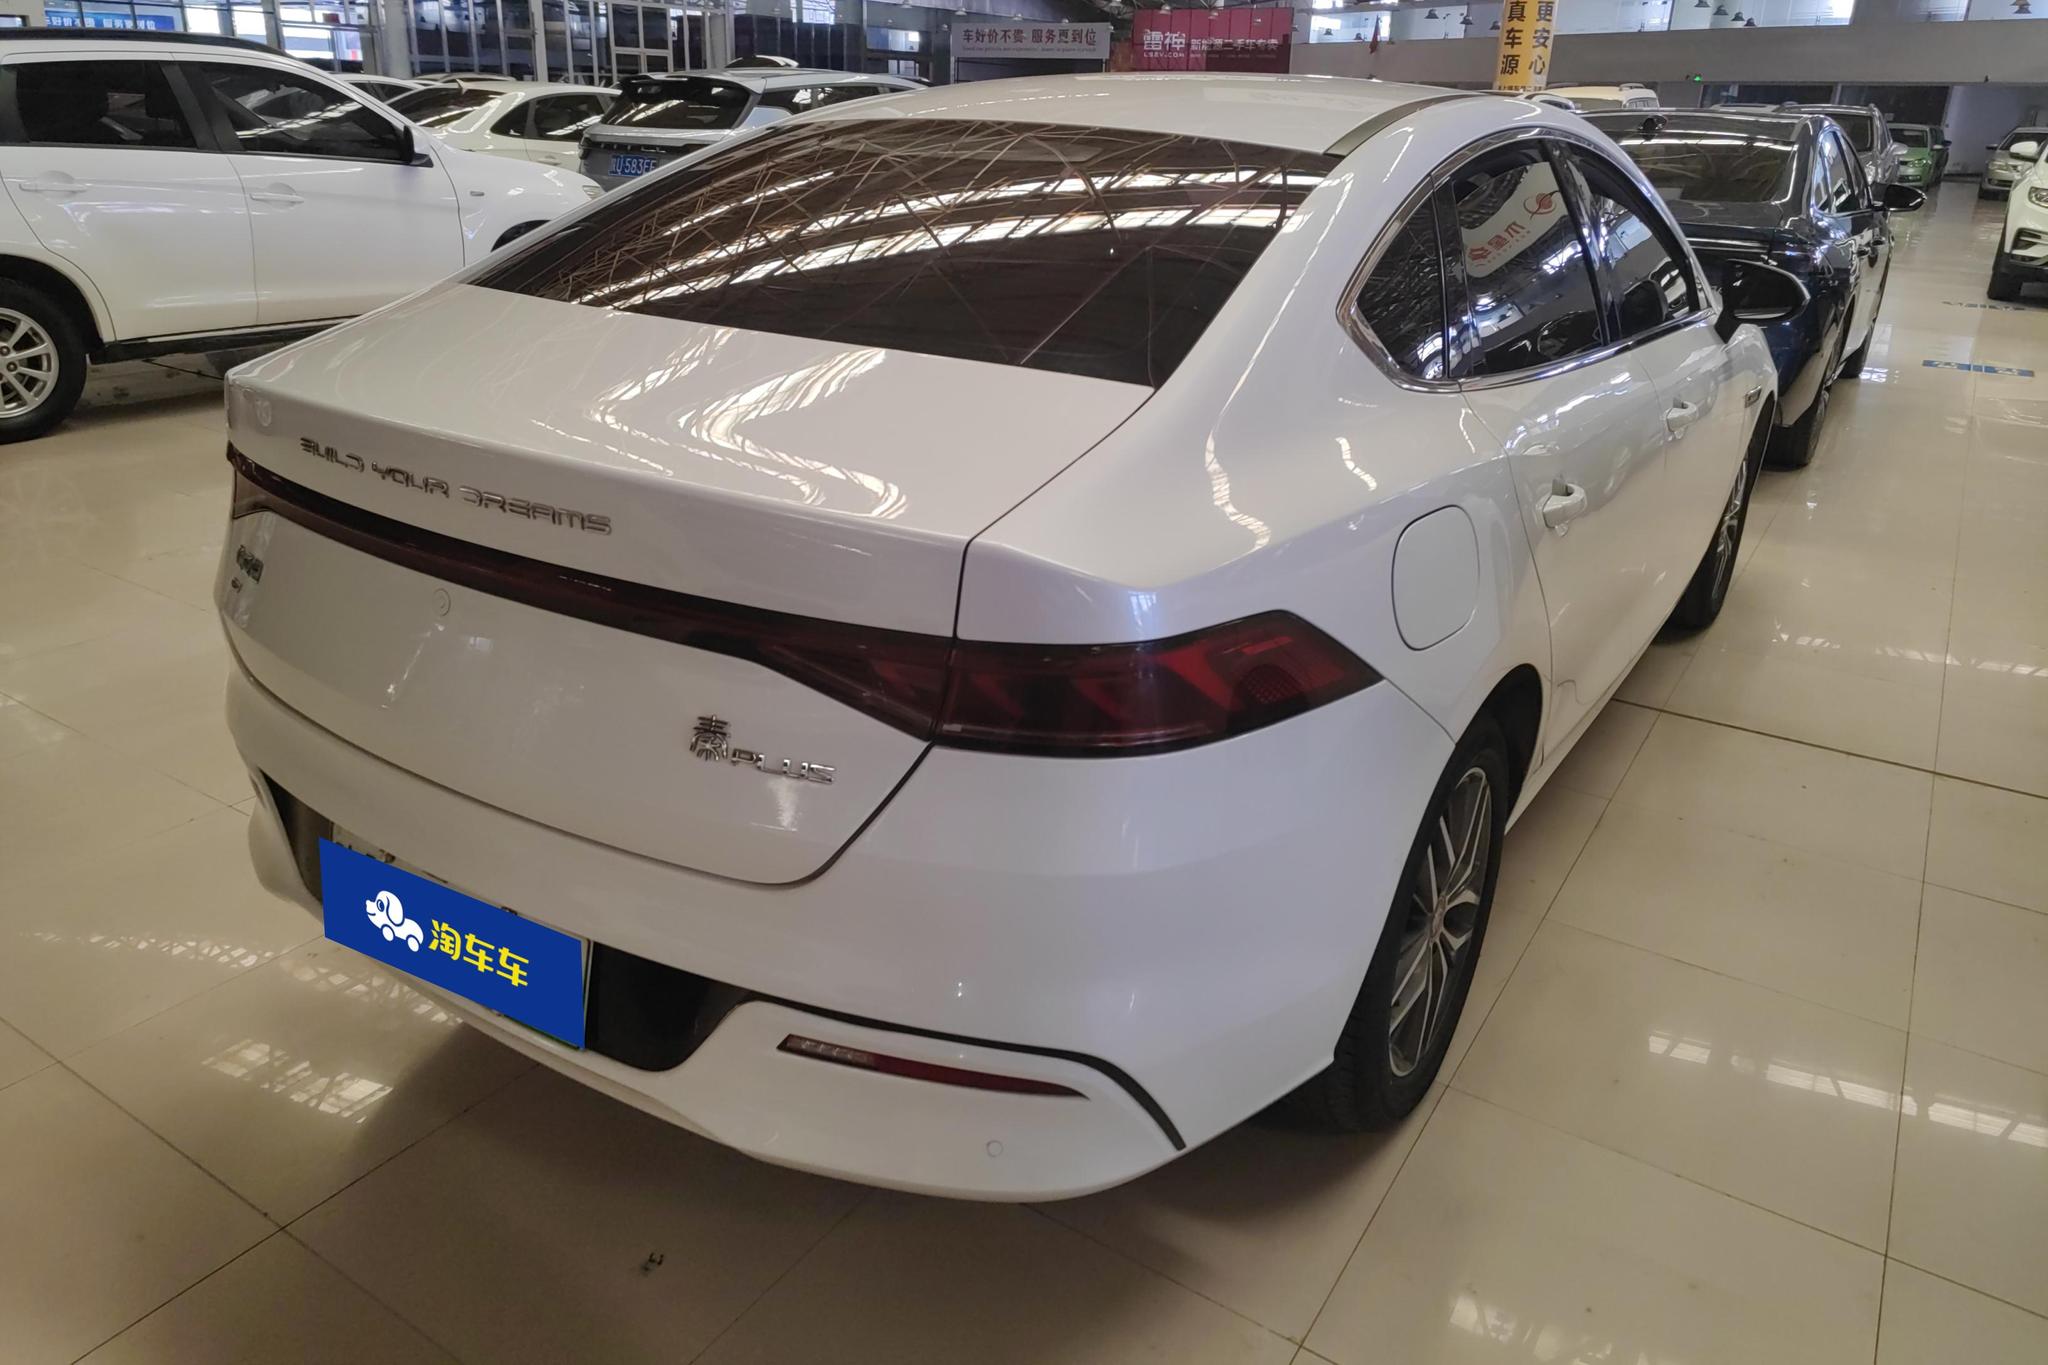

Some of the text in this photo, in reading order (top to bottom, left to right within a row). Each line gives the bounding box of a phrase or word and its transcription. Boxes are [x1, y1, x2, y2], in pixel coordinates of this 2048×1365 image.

[1031, 28, 1097, 45] 服务更到位
[1143, 29, 1186, 51] 雷神
[1500, 0, 1527, 75] 真车源
[1528, 1, 1554, 75] 更安心
[300, 436, 613, 536] BUILD YOUR DREAMS
